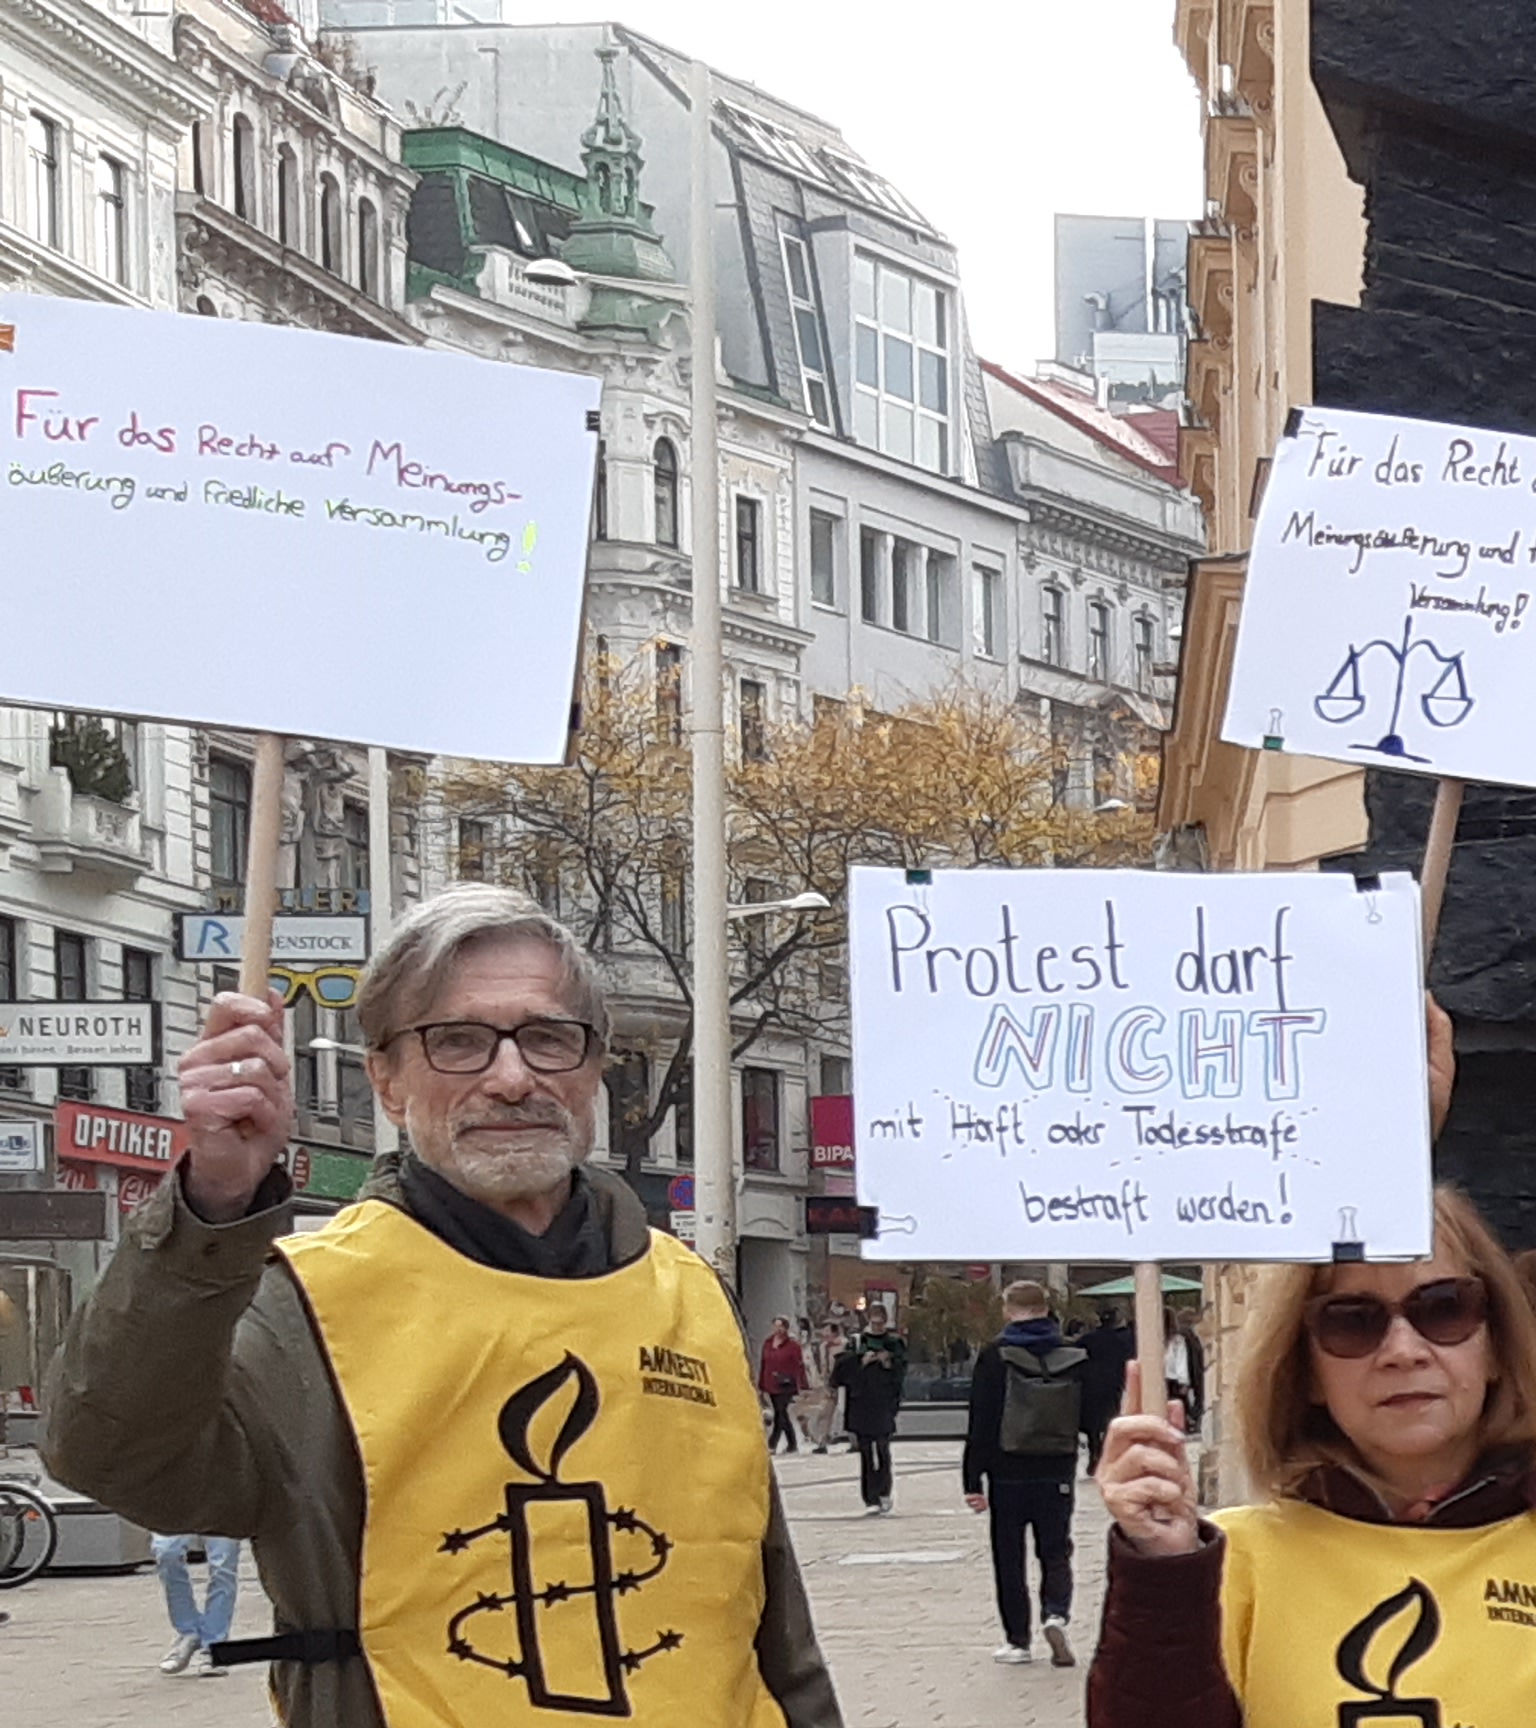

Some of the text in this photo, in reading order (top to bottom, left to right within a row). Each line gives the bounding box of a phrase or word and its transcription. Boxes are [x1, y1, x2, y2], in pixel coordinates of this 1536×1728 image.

[16, 389, 524, 513] Für das Recht auf Meinungs-
[1306, 431, 1364, 478] Für
[1375, 434, 1424, 484] das
[1442, 438, 1522, 486] Recht
[8, 462, 136, 510] äußerung
[146, 482, 188, 502] und
[1281, 510, 1471, 579] Meinungsäußerung
[1478, 530, 1519, 565] und
[885, 900, 1293, 1013] Protest darf
[19, 1016, 142, 1037] NEUROTH
[973, 1002, 1326, 1101] NICHT
[75, 1114, 174, 1160] OPTIKER
[813, 1145, 855, 1163] BIPA
[869, 1100, 1299, 1161] mit Haft oder Todesstrafe
[1019, 1181, 1150, 1234] bestraft
[638, 1345, 711, 1386] AMNESTY
